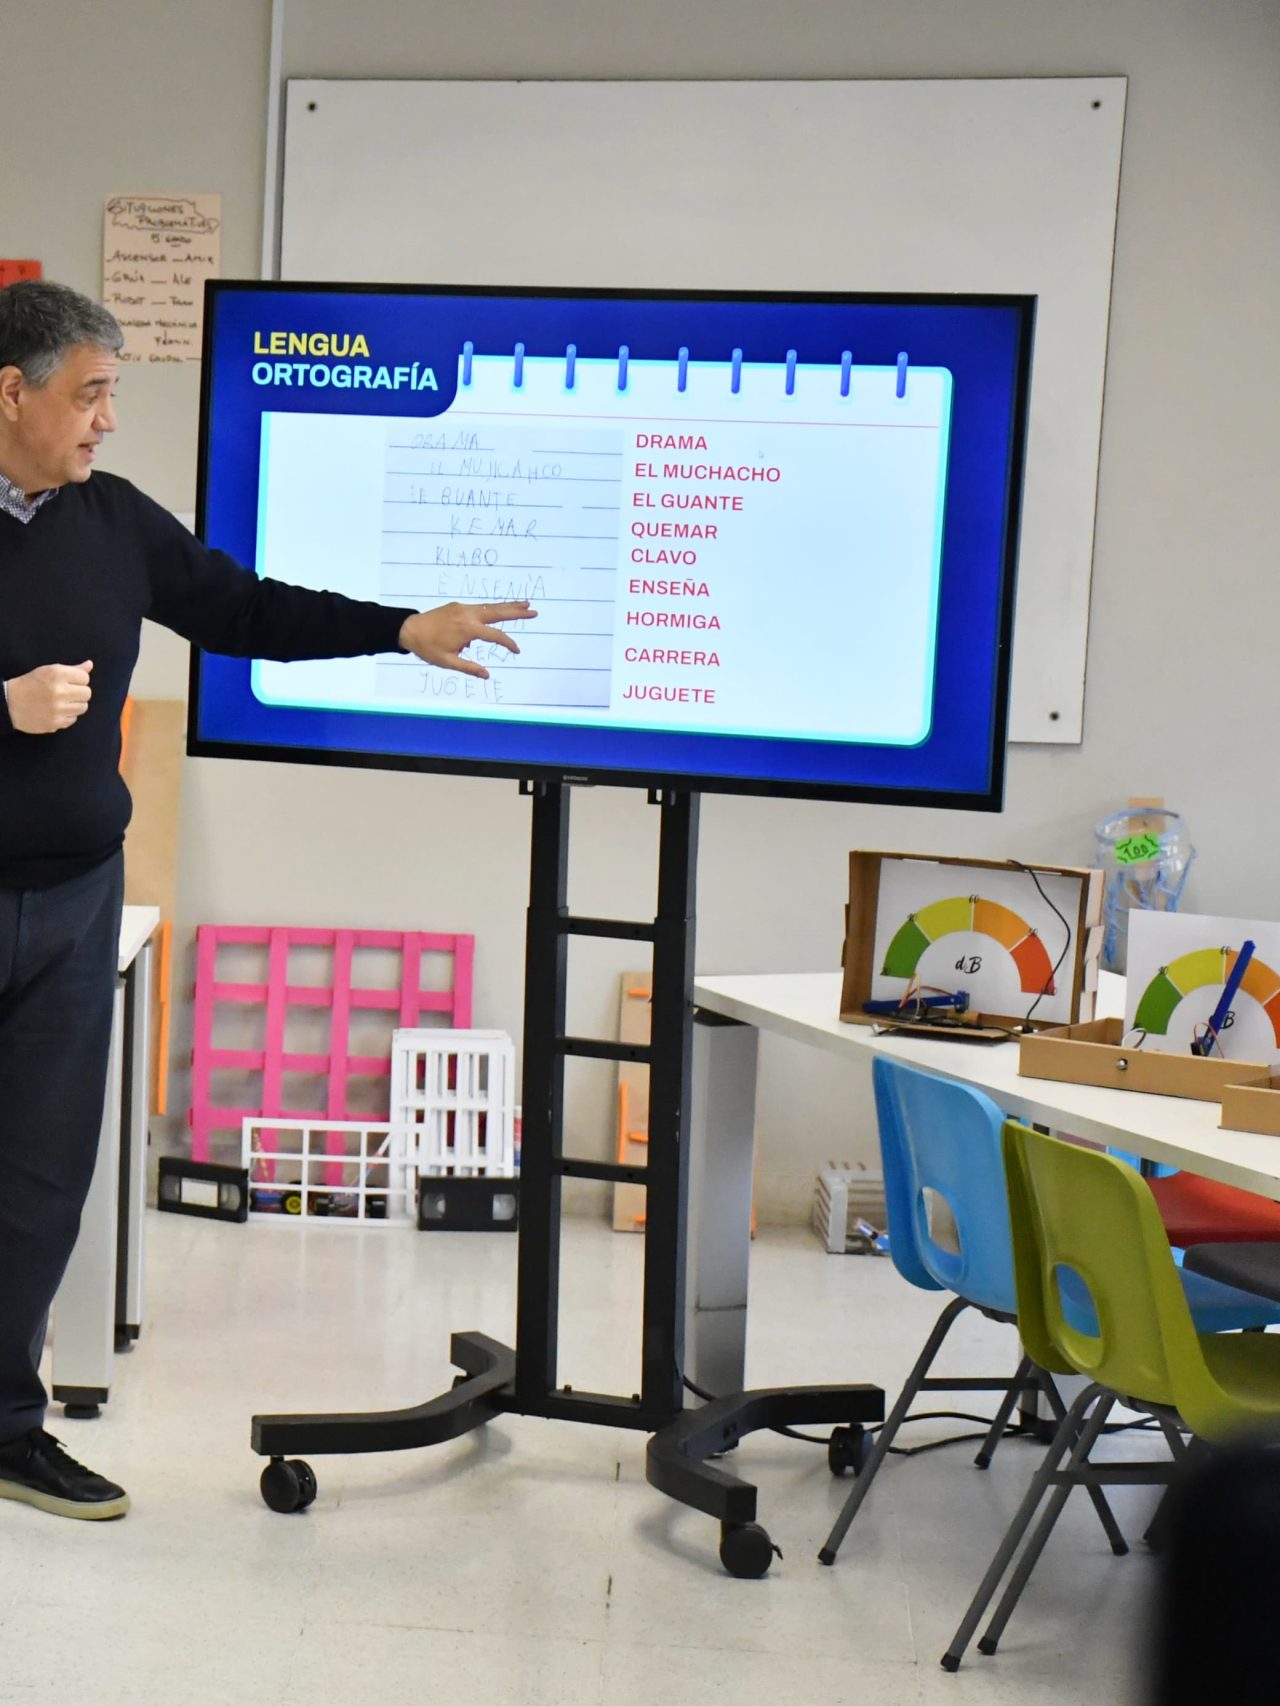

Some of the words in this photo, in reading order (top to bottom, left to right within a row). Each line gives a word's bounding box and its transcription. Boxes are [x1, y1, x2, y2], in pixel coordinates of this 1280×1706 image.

[253, 331, 370, 358] LENGUA
[251, 361, 439, 391] ORTOGRAFÍA
[636, 434, 708, 450] DRAMA
[636, 463, 659, 478] EL
[663, 463, 782, 483] MUCHACHO
[633, 492, 658, 509] EL
[661, 493, 745, 512] GUANTE
[631, 523, 719, 540] QUEMAR
[631, 548, 698, 566] CLAVO
[629, 578, 711, 598] ENSEÑA
[626, 612, 722, 630] HORMIGA
[625, 648, 721, 667] CARRERA
[623, 686, 716, 705] JUGUETE
[955, 956, 983, 974] dB
